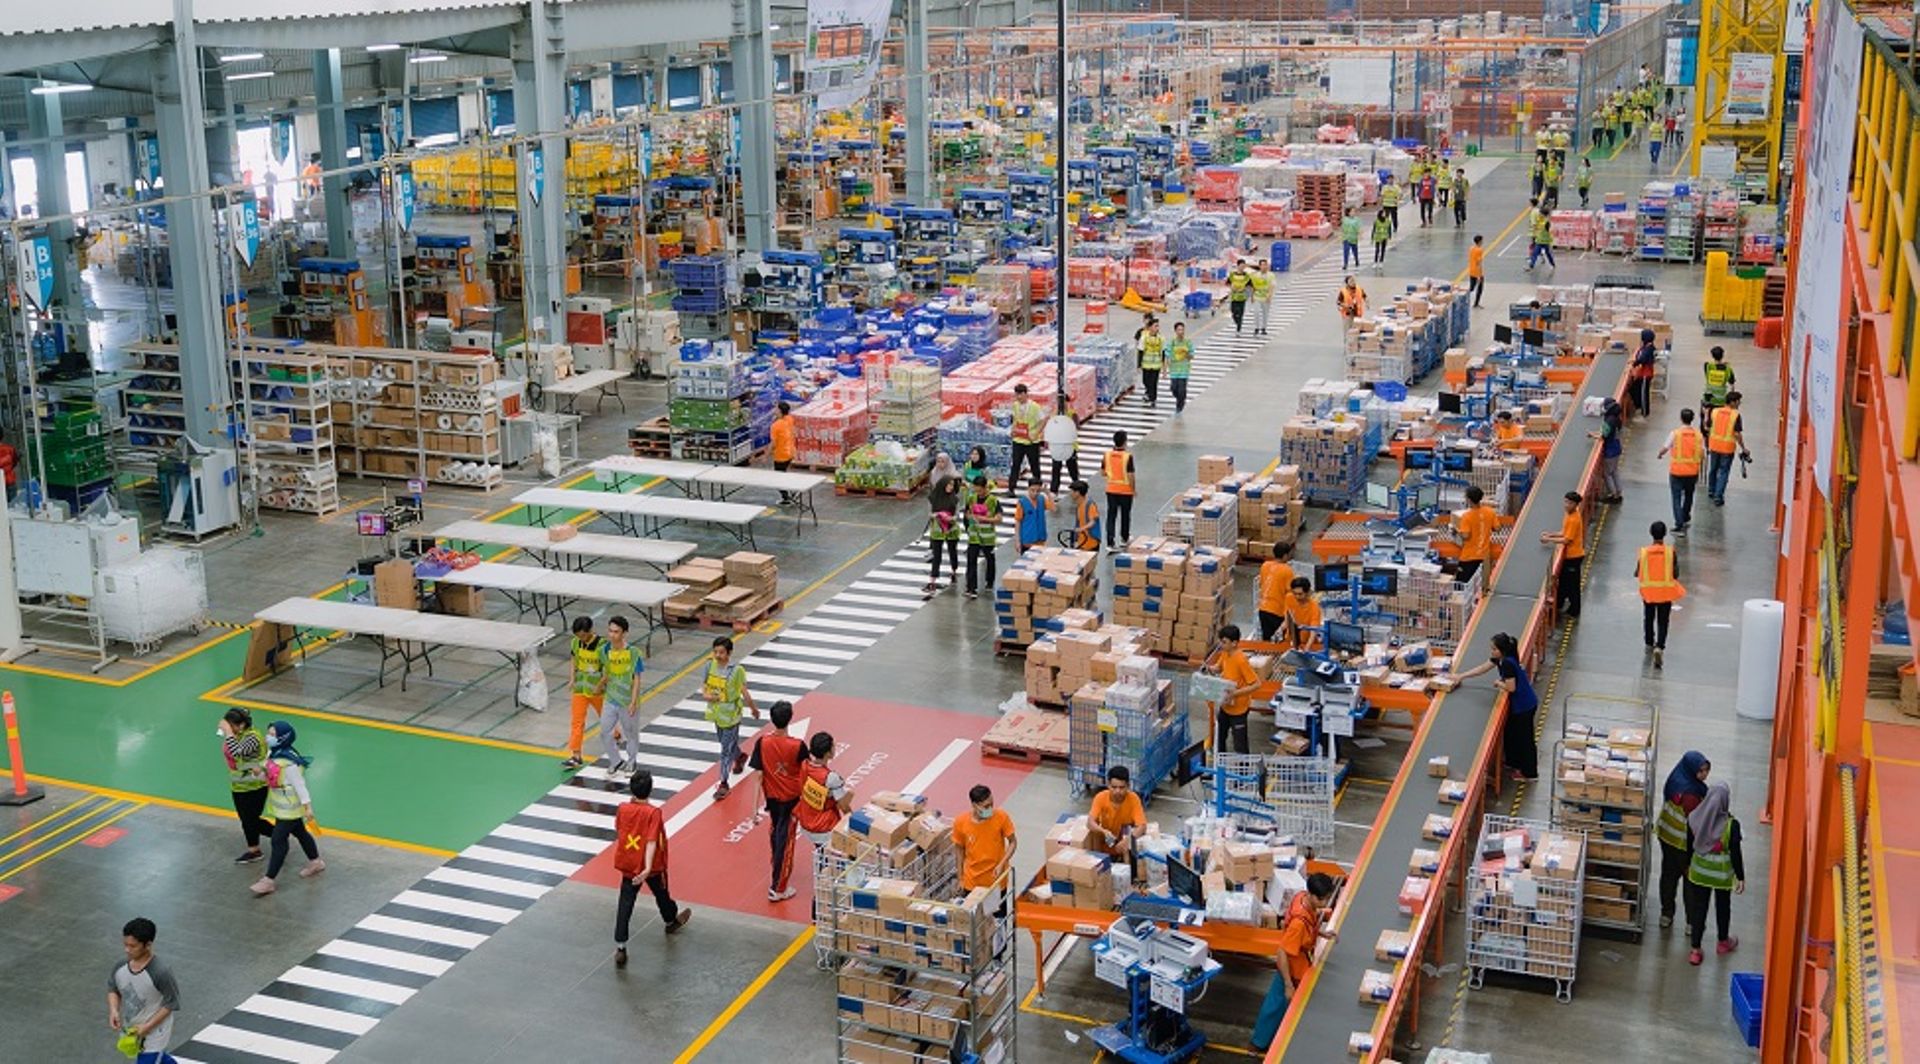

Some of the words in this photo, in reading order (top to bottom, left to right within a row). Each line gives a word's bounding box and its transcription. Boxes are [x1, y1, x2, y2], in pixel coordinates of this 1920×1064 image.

[245, 207, 255, 225] B
[36, 245, 50, 264] B
[39, 266, 53, 280] 34
